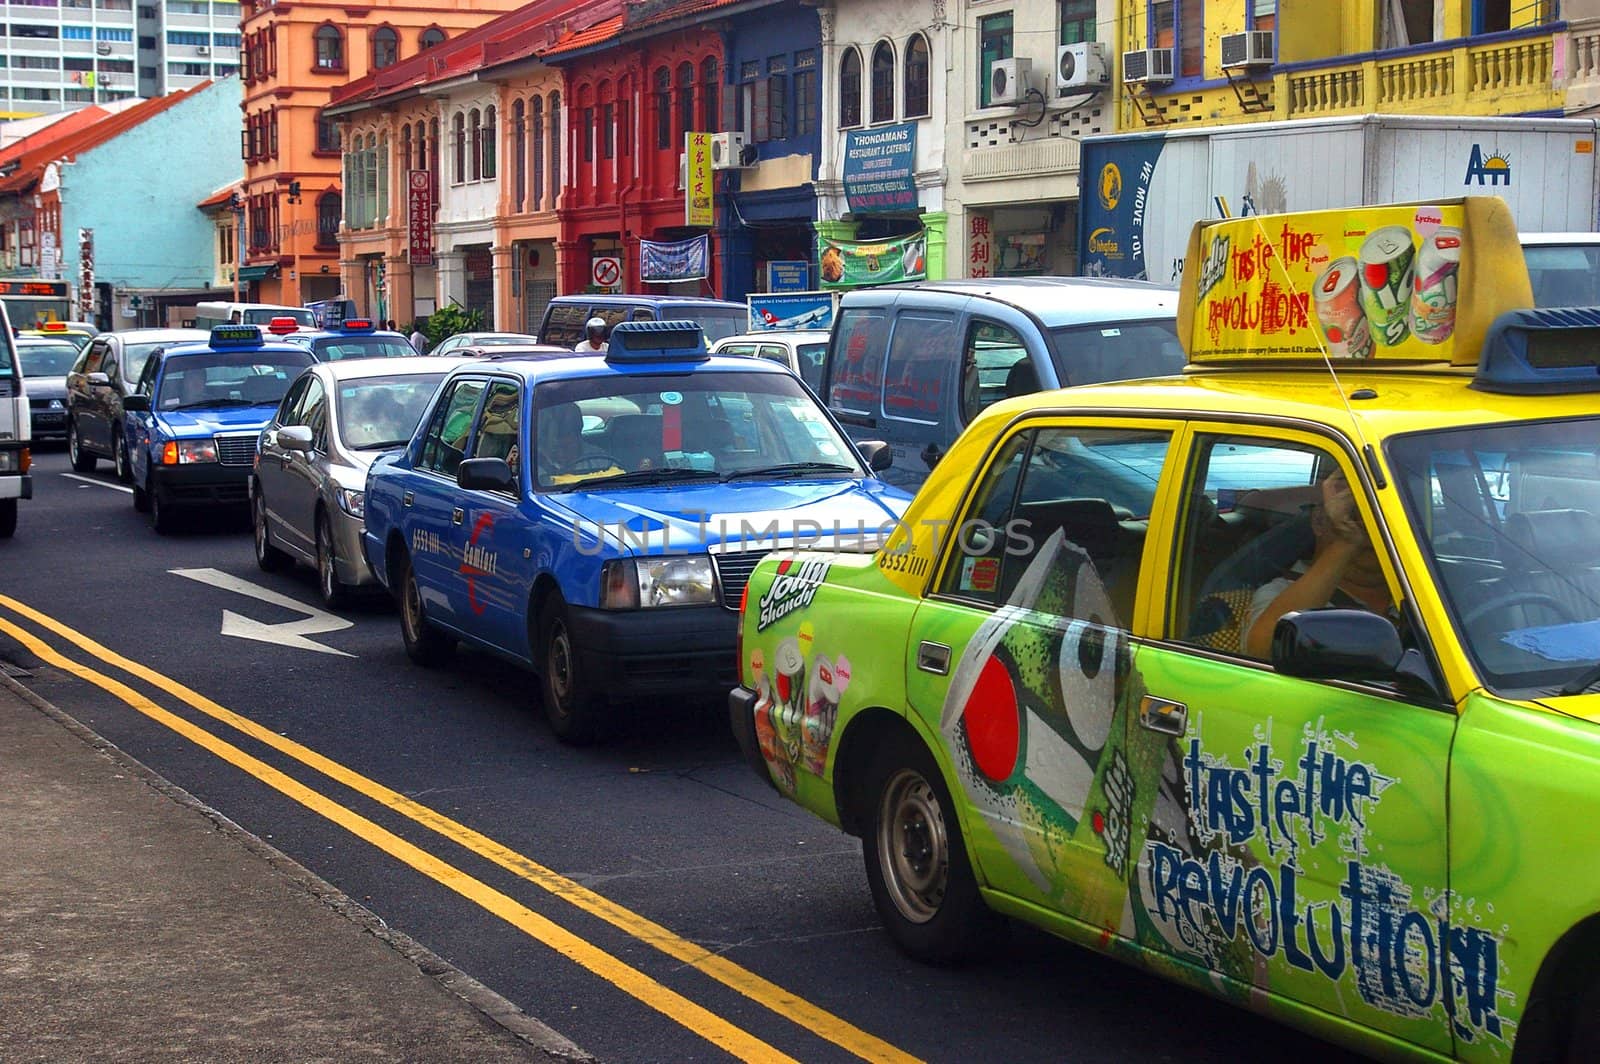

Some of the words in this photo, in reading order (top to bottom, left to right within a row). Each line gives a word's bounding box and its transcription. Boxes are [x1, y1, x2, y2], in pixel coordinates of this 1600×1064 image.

[854, 130, 908, 146] THONDAMANS
[1140, 161, 1153, 184] WE
[1133, 187, 1146, 226] MOVE
